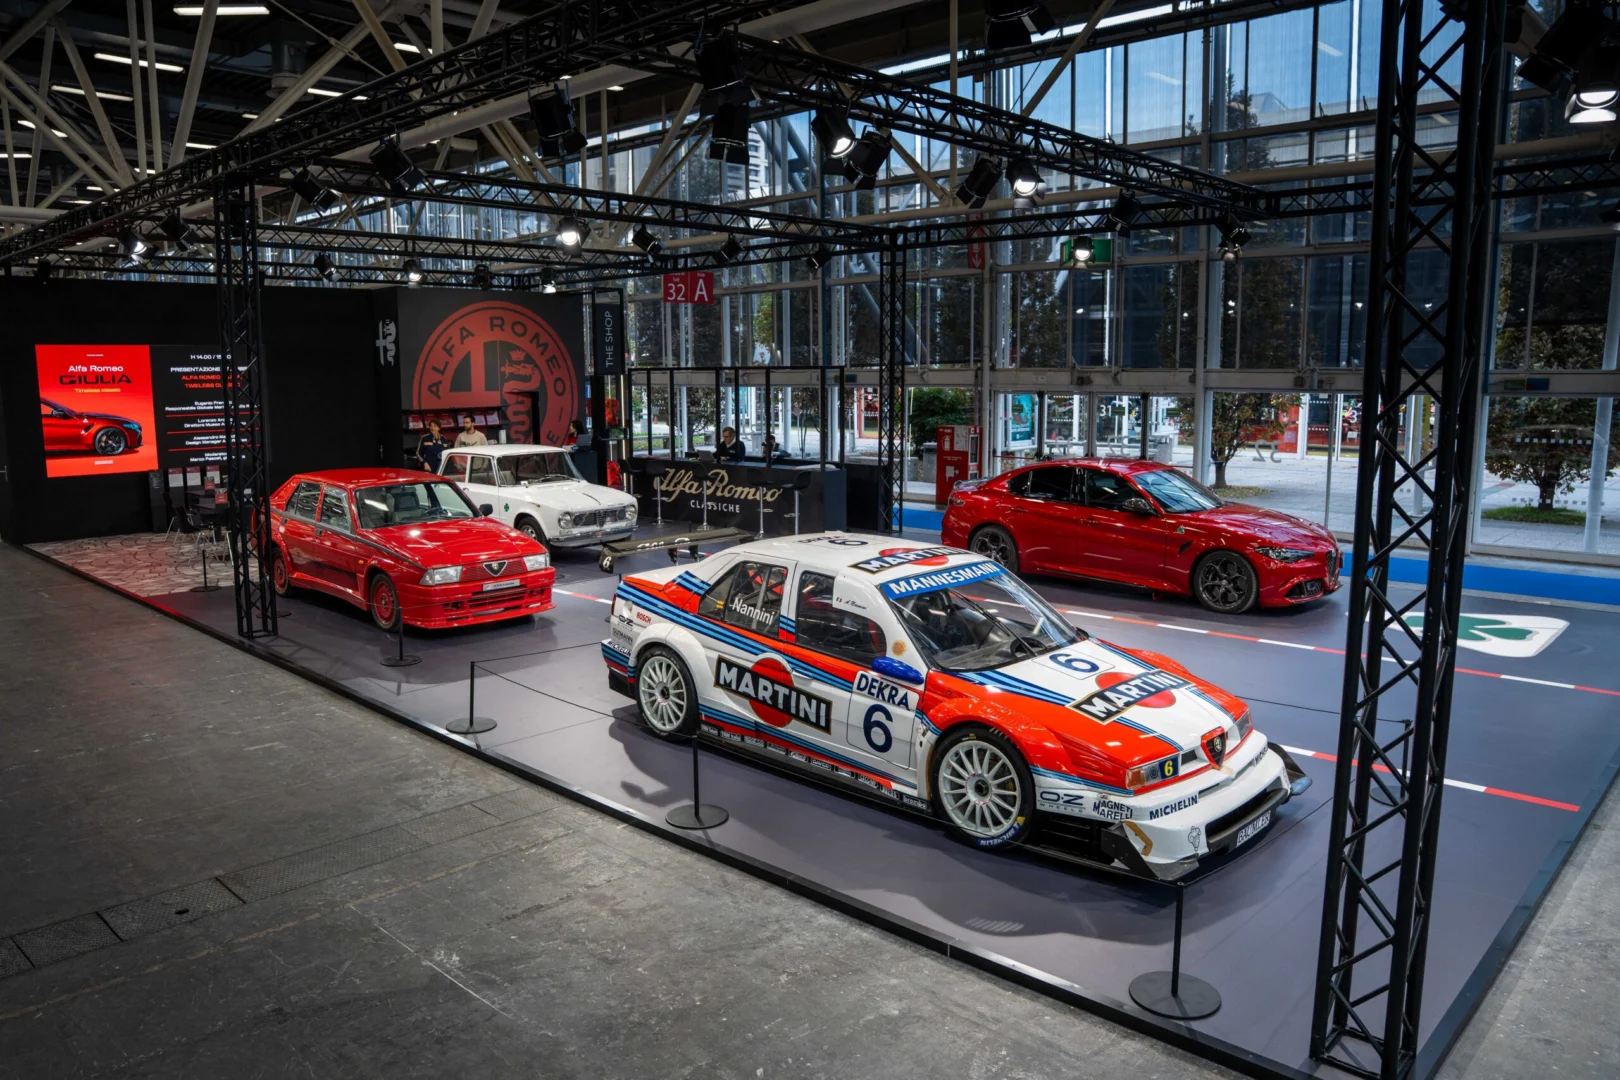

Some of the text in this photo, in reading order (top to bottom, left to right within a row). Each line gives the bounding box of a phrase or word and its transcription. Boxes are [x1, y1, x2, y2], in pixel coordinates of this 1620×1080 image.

[668, 283, 686, 300] 32
[695, 279, 708, 302] A
[604, 311, 614, 368] THE SHOP
[68, 365, 124, 373] Alfa Romeo
[428, 316, 566, 400] ALFA ROMEO
[59, 374, 132, 385] GIULIA
[1099, 405, 1112, 416] 31
[653, 468, 783, 502] Alfa Romeo
[602, 556, 612, 568] 6
[888, 561, 1000, 595] MANNESMANN
[636, 611, 651, 624] BOSCH
[732, 597, 776, 625] Nannini
[1049, 653, 1100, 673] 6
[718, 661, 827, 727] MARTINI
[856, 673, 910, 710] DEKRA
[1081, 672, 1184, 720] MARTINI
[863, 703, 894, 753] 6
[1163, 760, 1174, 777] 6
[1149, 794, 1198, 821] MICHELIN
